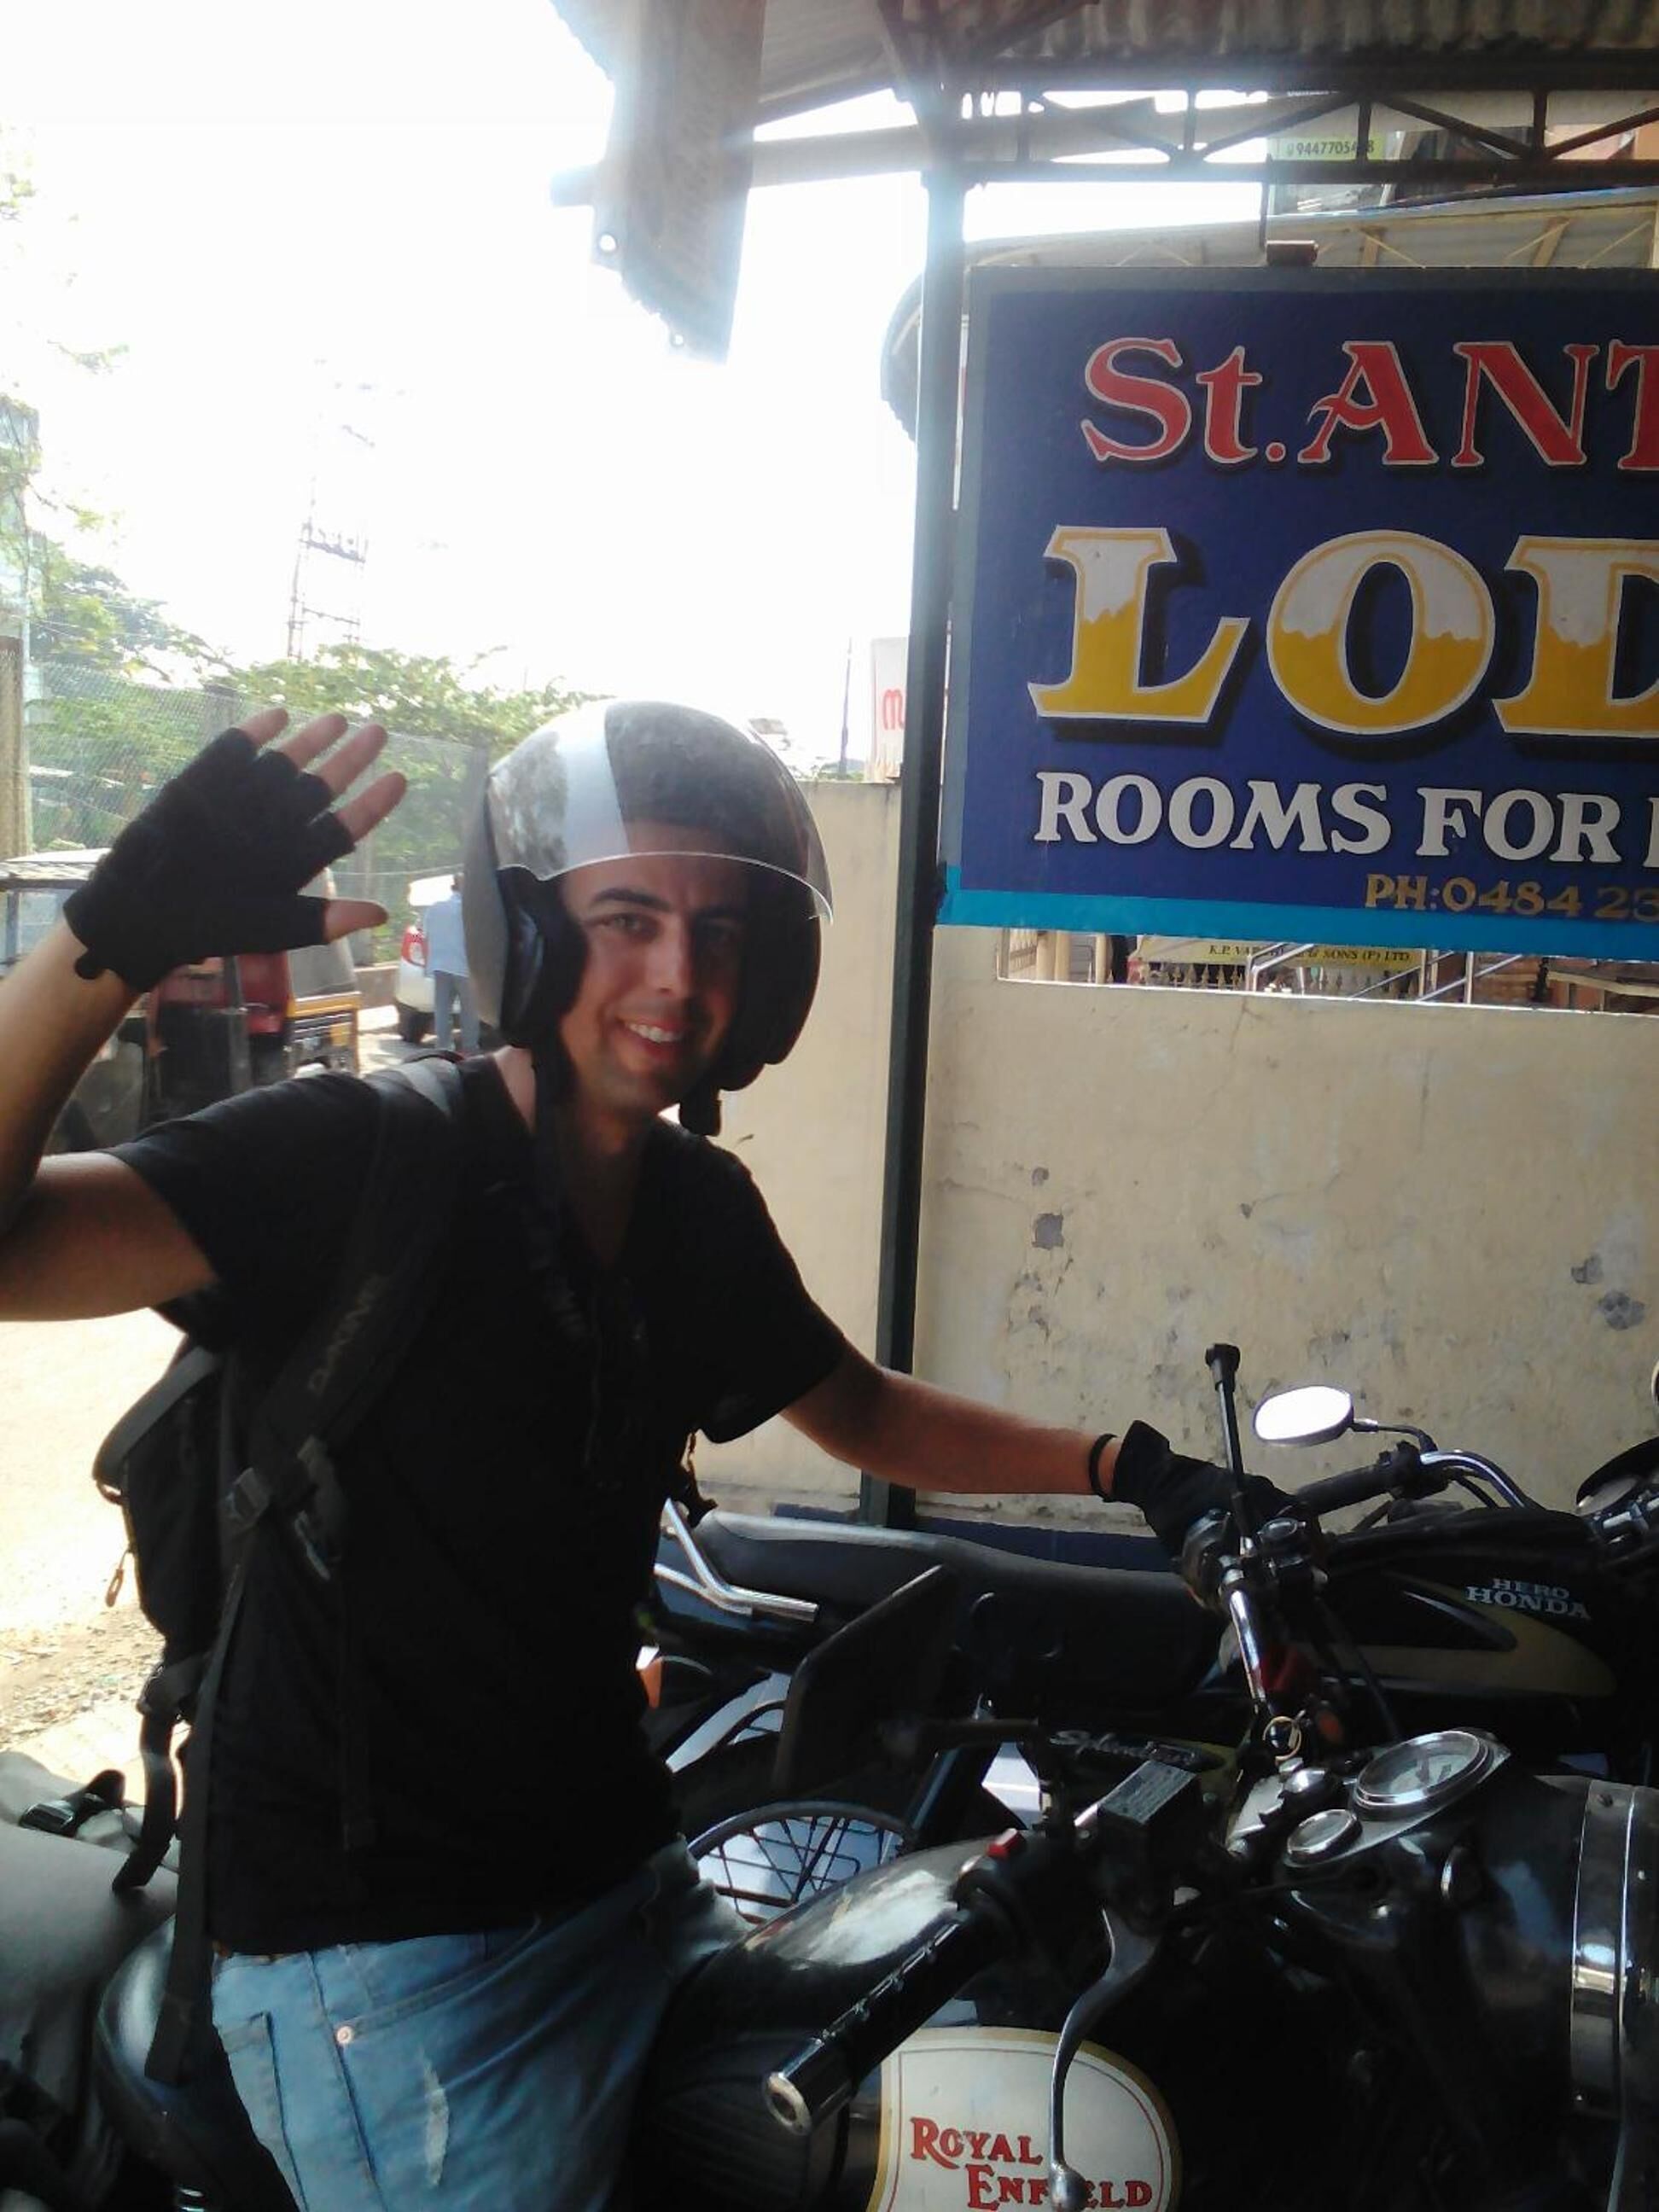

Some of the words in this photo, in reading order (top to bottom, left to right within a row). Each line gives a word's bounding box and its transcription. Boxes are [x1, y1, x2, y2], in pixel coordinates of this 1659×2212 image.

[1034, 771, 1392, 856] ROOMS
[1415, 787, 1622, 864] FOR
[1465, 1586, 1592, 1621] HONDA
[1492, 1578, 1570, 1600] HERO
[910, 2117, 1043, 2169] ROYAL
